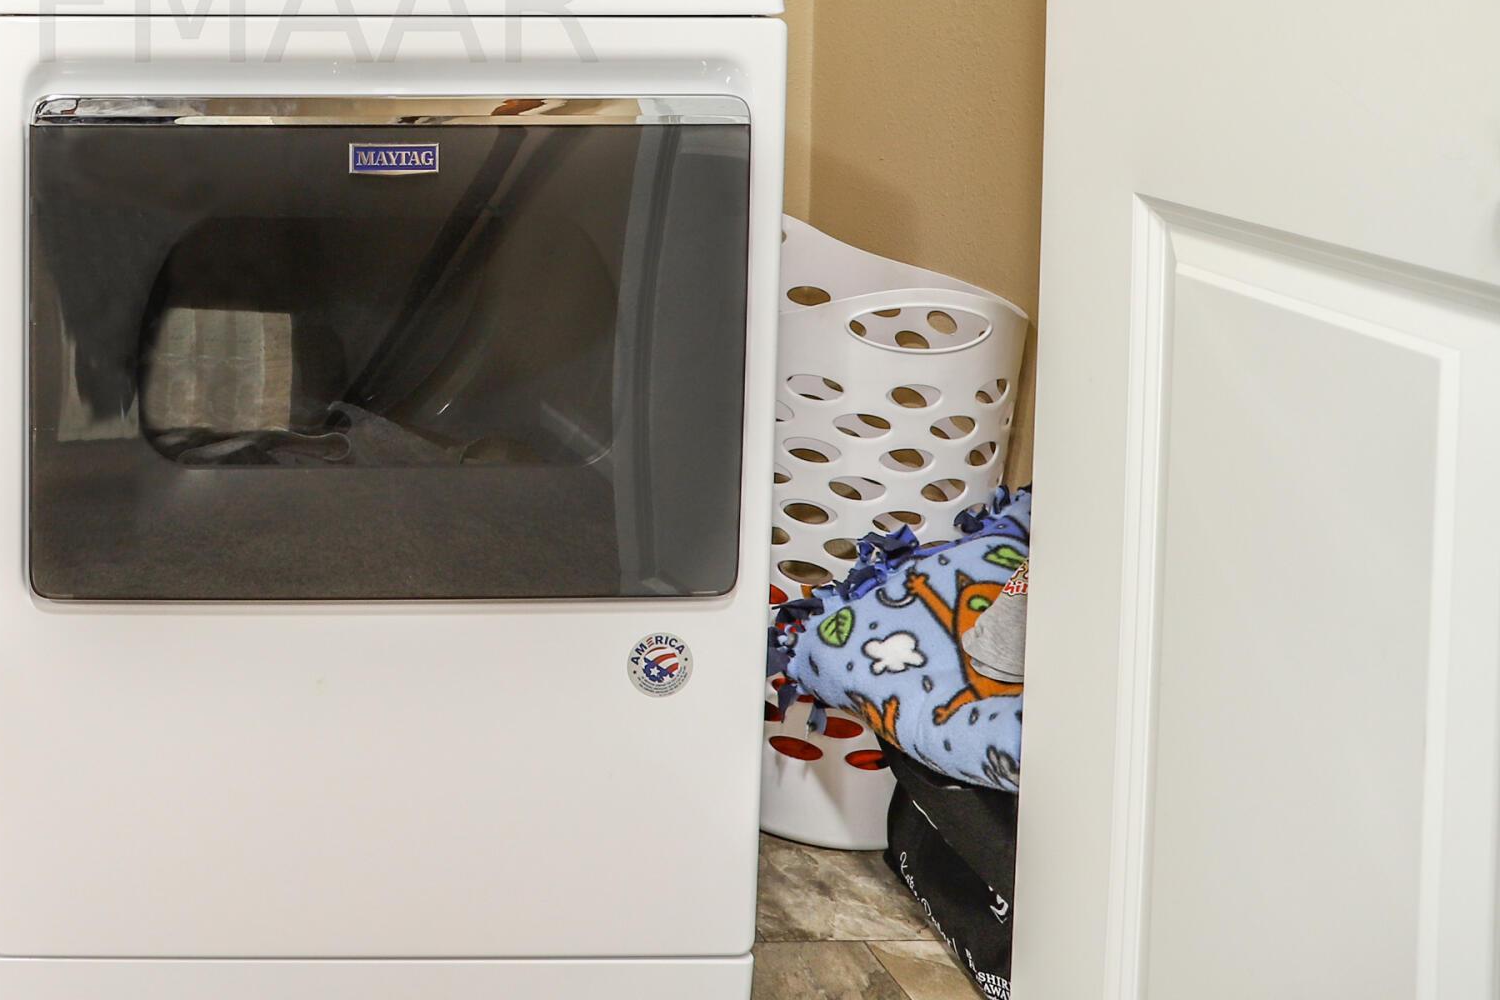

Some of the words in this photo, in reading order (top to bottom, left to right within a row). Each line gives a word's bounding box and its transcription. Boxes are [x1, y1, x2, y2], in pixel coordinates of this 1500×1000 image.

[355, 150, 435, 167] MAYTAG
[630, 635, 686, 666] AMERICA
[977, 971, 1011, 990] SHIR
